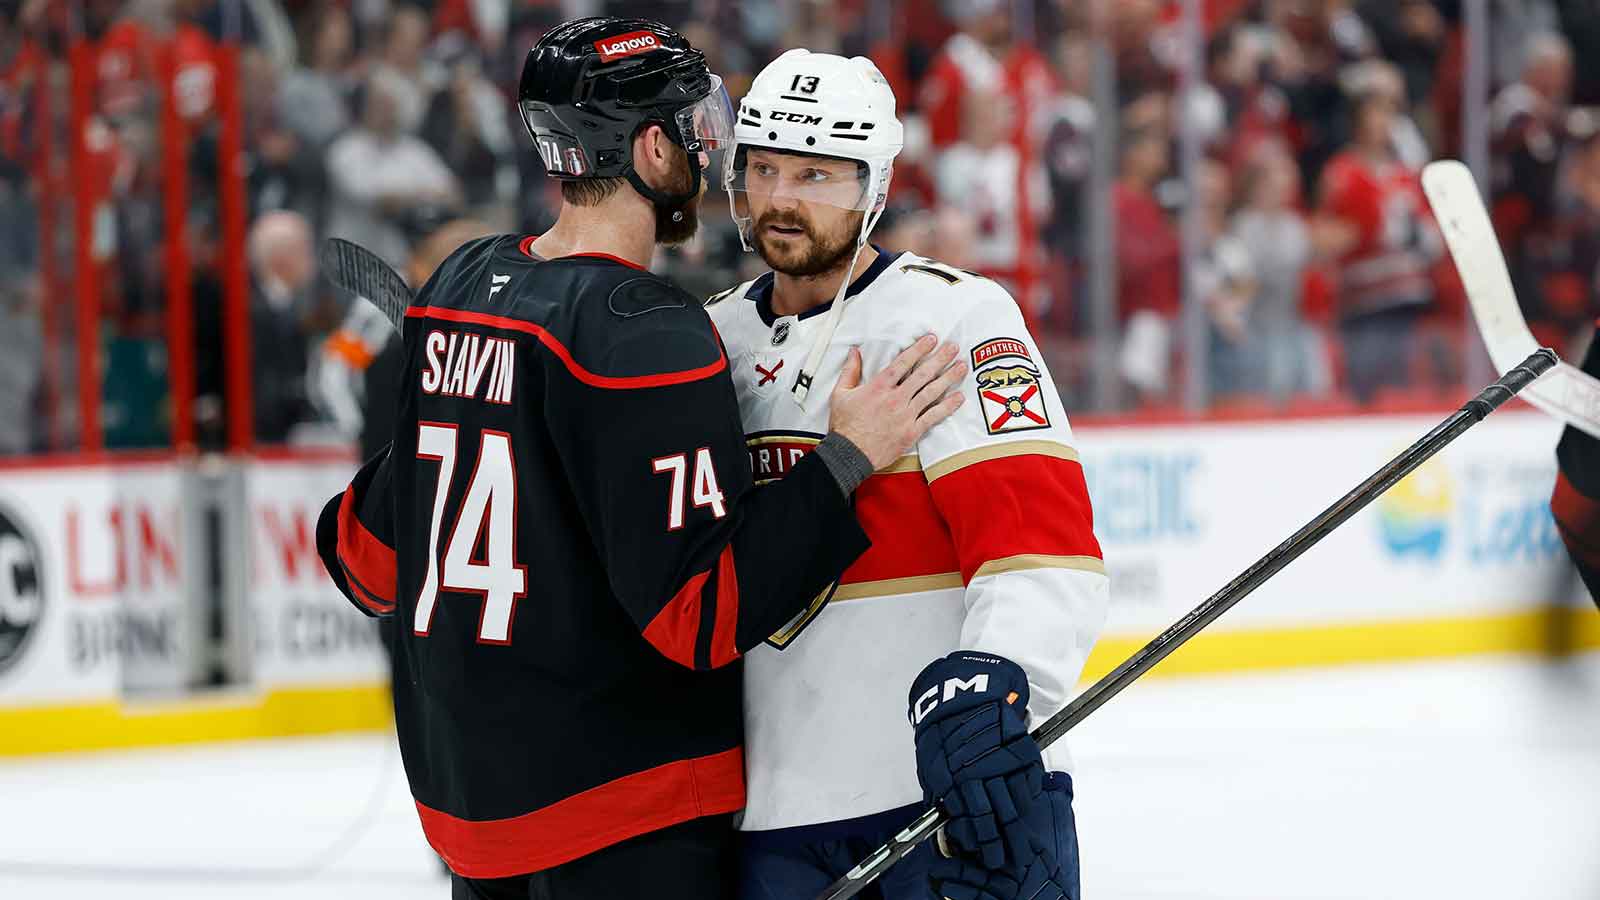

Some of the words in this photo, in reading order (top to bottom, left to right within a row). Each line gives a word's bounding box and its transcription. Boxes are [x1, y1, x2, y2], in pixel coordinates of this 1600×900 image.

[601, 35, 656, 56] Lenovo
[790, 74, 821, 94] 13
[769, 110, 824, 126] CCM
[541, 141, 564, 171] 74
[979, 342, 1026, 360] PANTHERS
[422, 330, 516, 404] SLAVIN
[652, 447, 727, 531] 74
[414, 420, 529, 646] 74
[910, 673, 990, 726] CM
